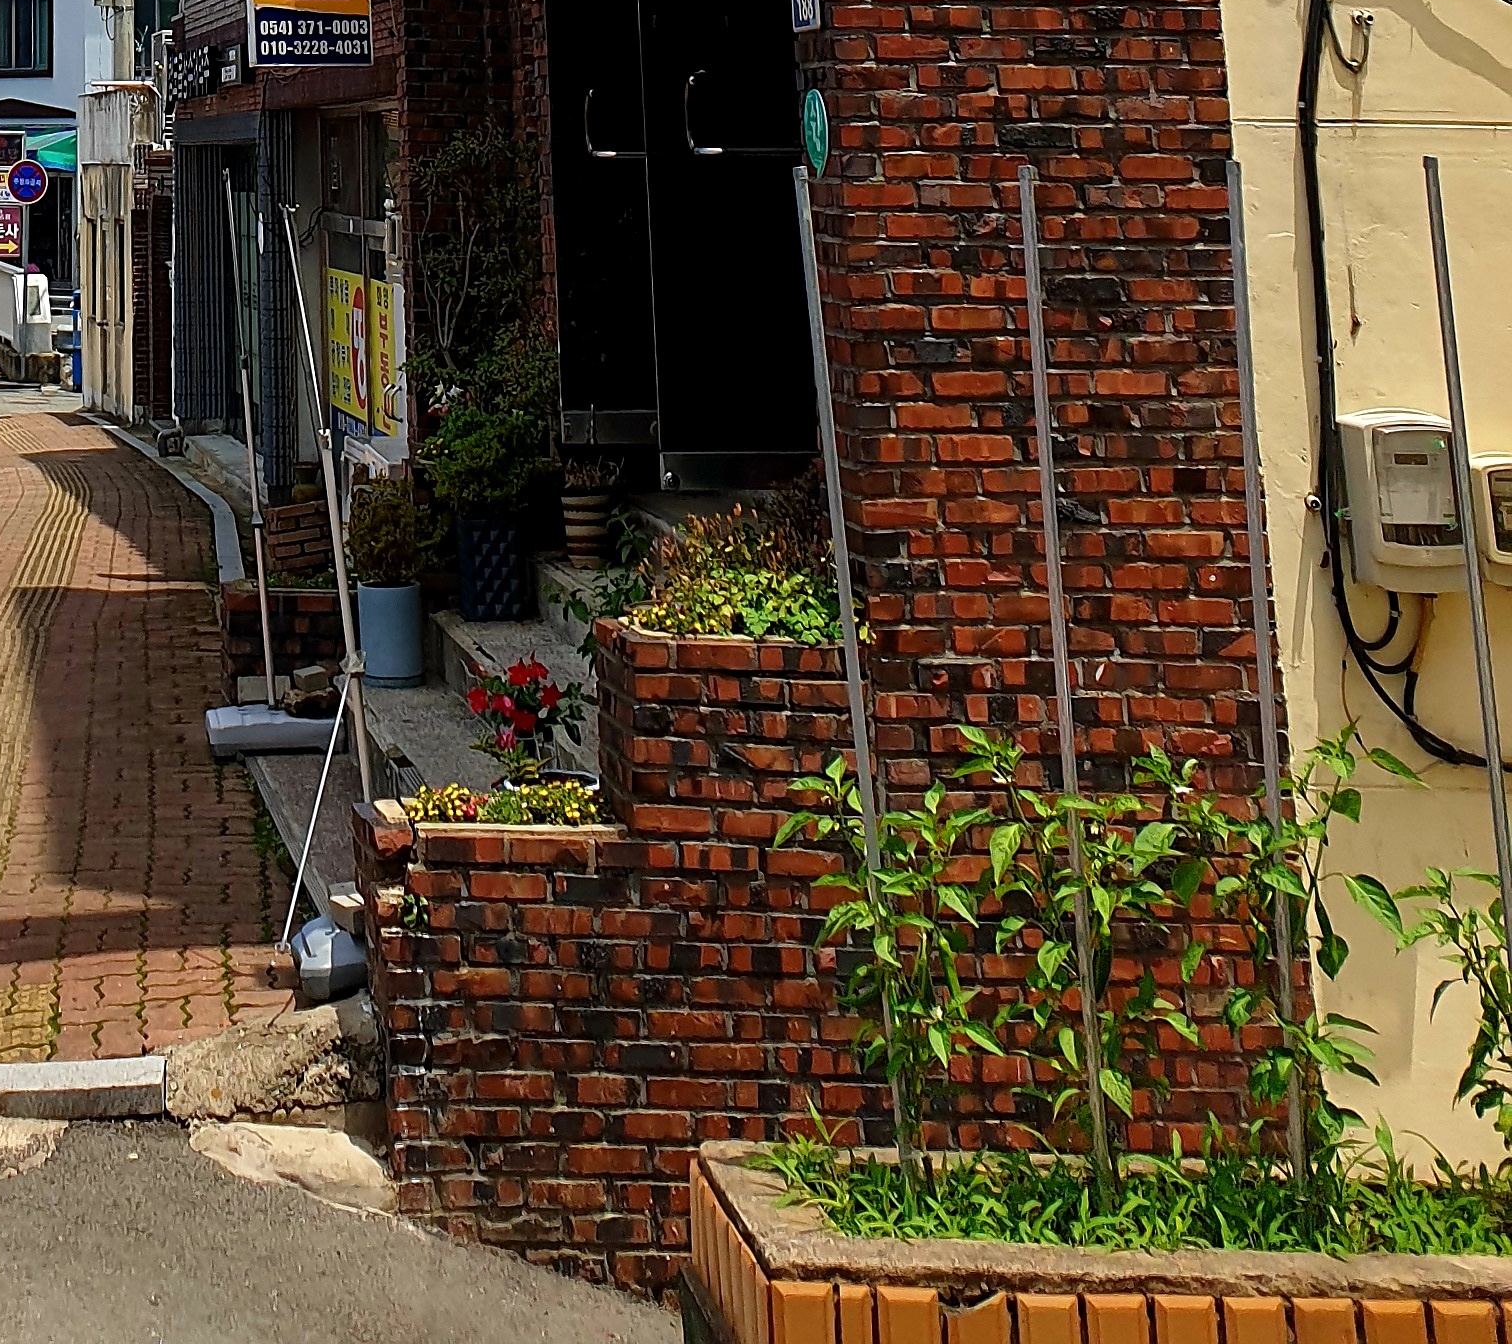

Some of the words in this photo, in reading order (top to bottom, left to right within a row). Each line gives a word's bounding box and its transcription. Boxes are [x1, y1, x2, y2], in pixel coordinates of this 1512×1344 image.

[260, 20, 293, 36] 054)
[297, 19, 369, 35] 371-0003
[260, 39, 369, 56] 010-3228-4031
